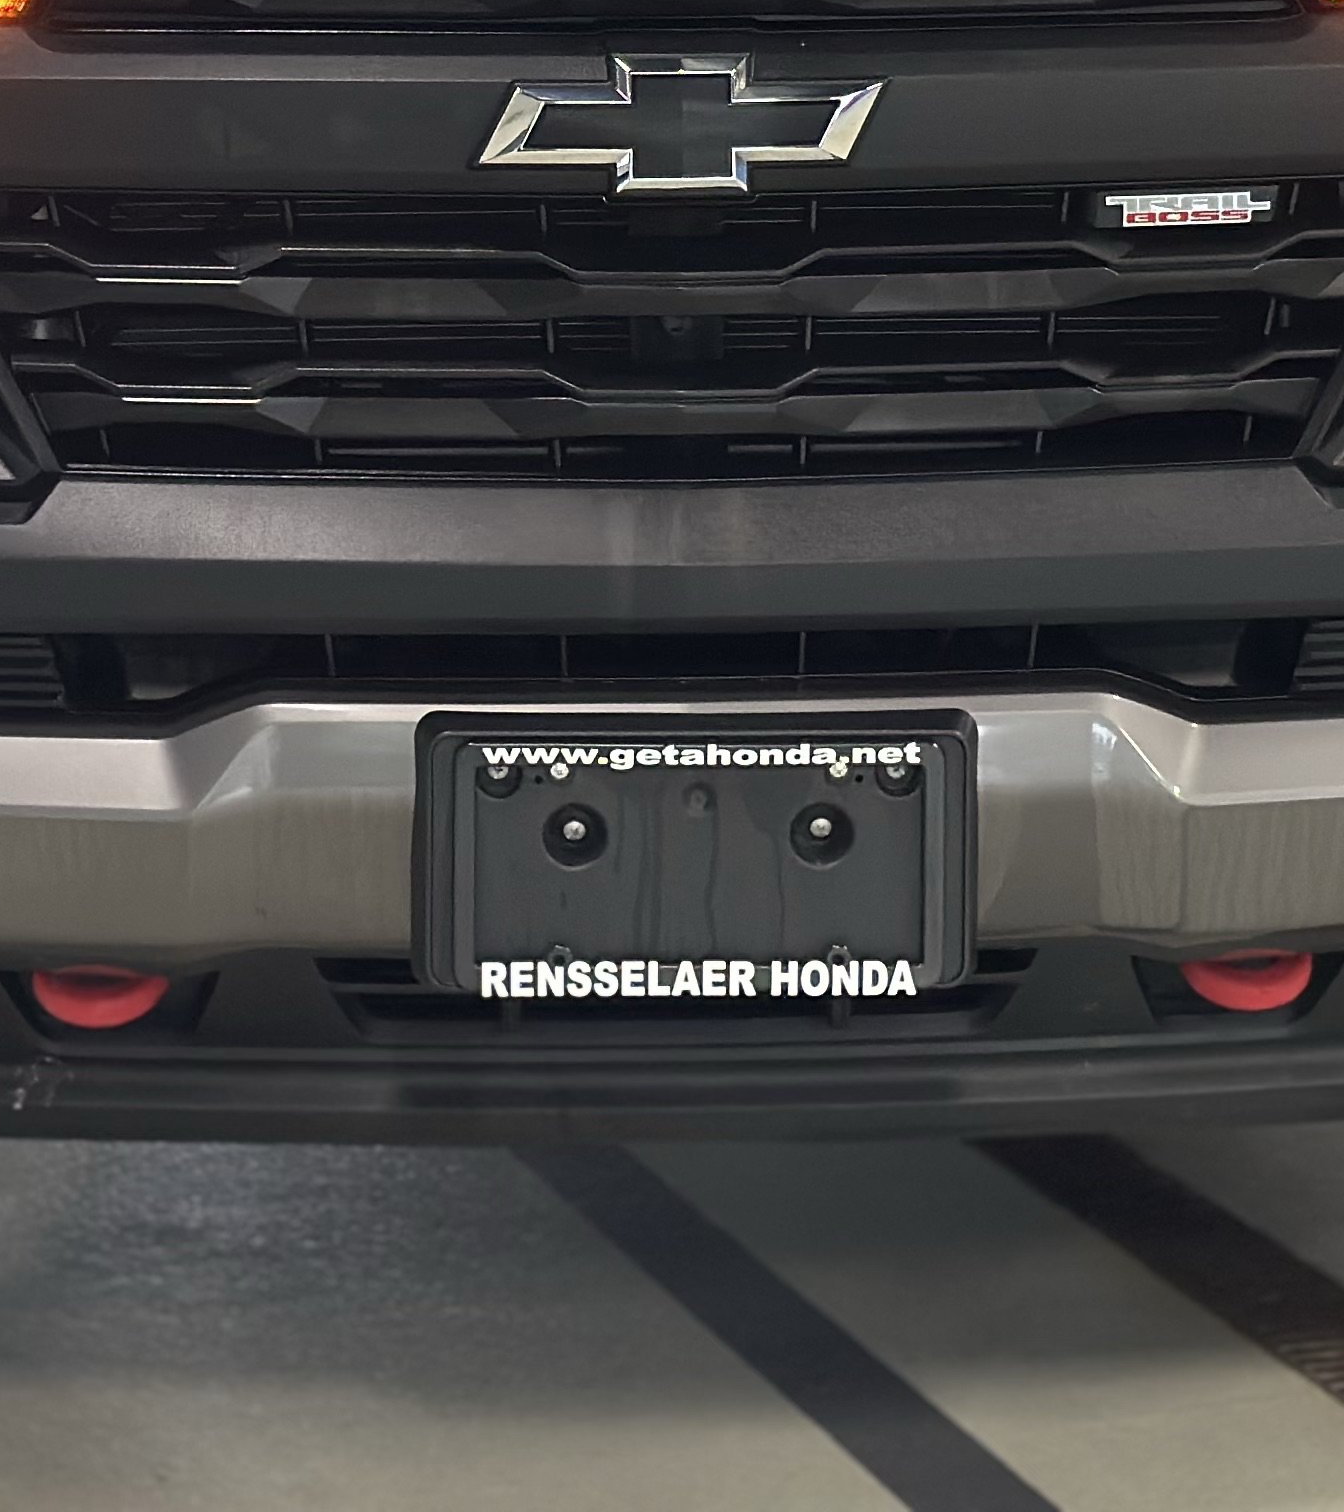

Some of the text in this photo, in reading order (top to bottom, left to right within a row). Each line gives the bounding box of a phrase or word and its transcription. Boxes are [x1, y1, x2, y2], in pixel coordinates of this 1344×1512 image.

[1106, 192, 1271, 213] TRAIL
[1125, 209, 1249, 225] BOSS
[481, 741, 922, 771] www.getahonda.net
[481, 961, 918, 998] RENSSELAER HONDA
